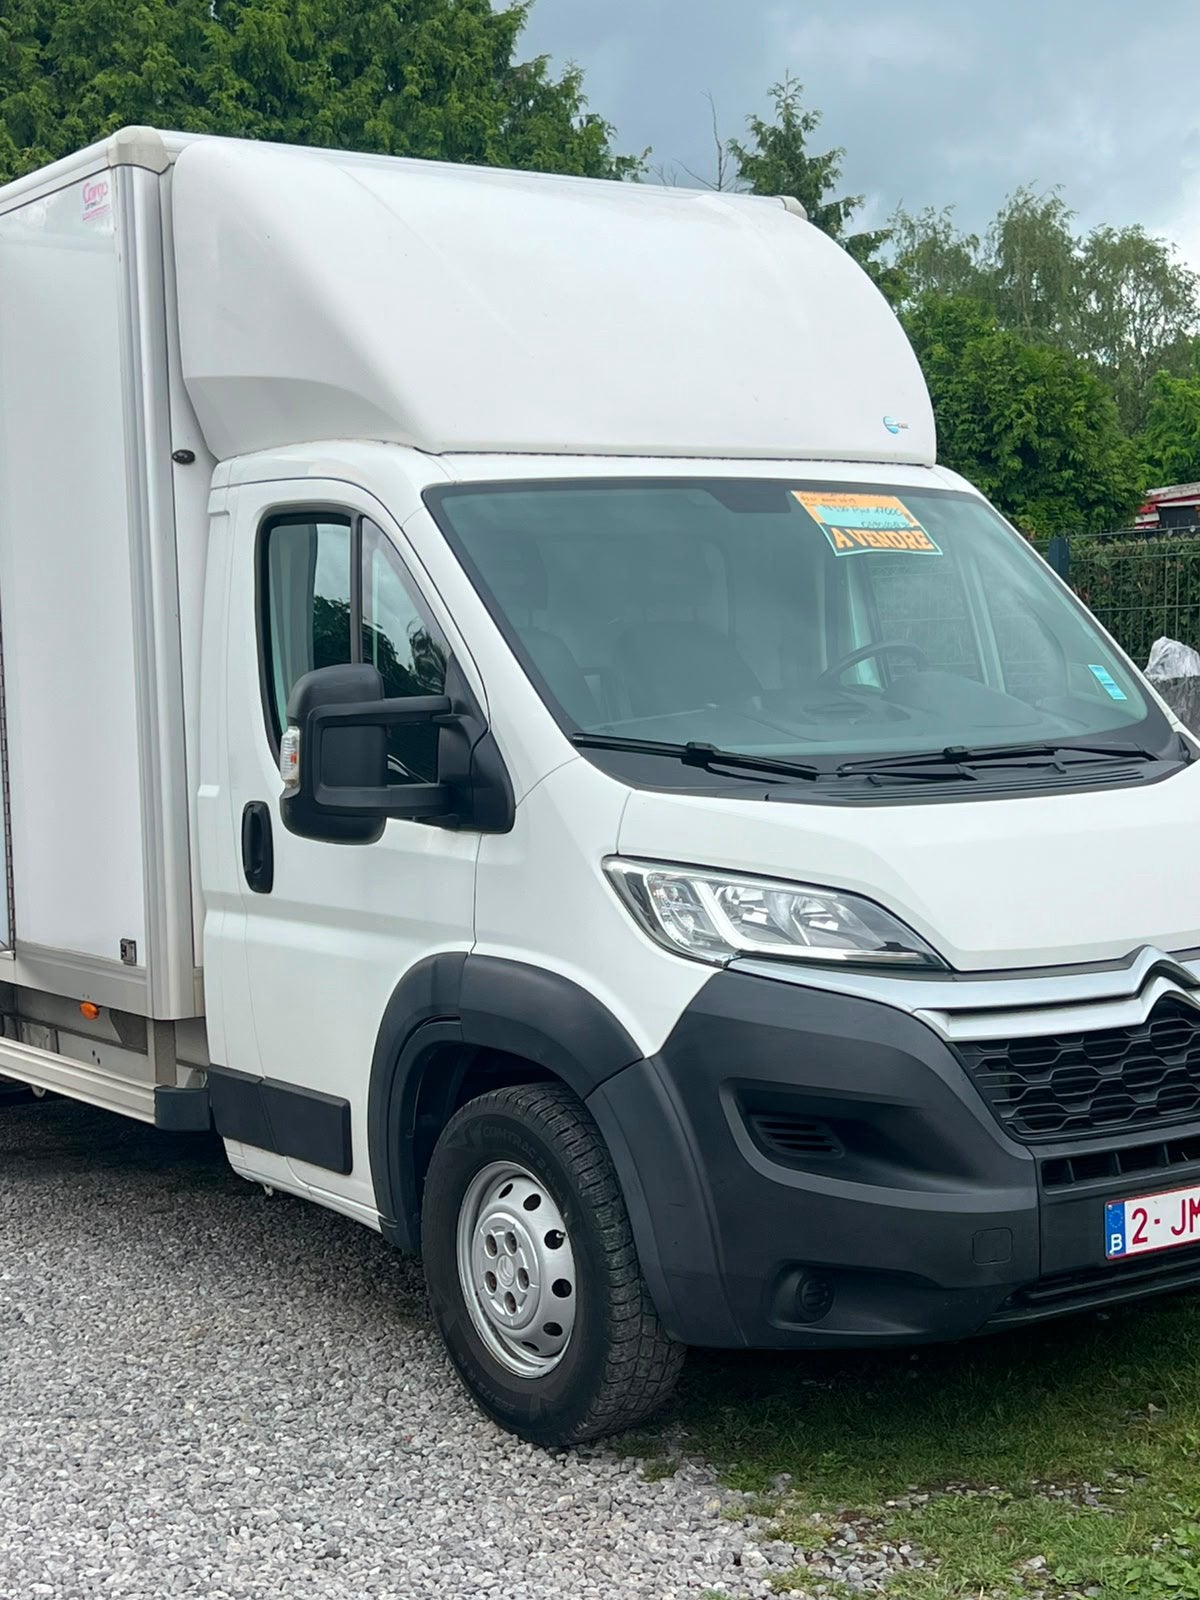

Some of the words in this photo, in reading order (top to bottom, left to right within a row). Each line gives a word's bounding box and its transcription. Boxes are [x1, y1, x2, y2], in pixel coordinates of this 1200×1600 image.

[831, 527, 855, 549] A
[844, 528, 935, 550] VENDRE
[1110, 1233, 1123, 1251] B
